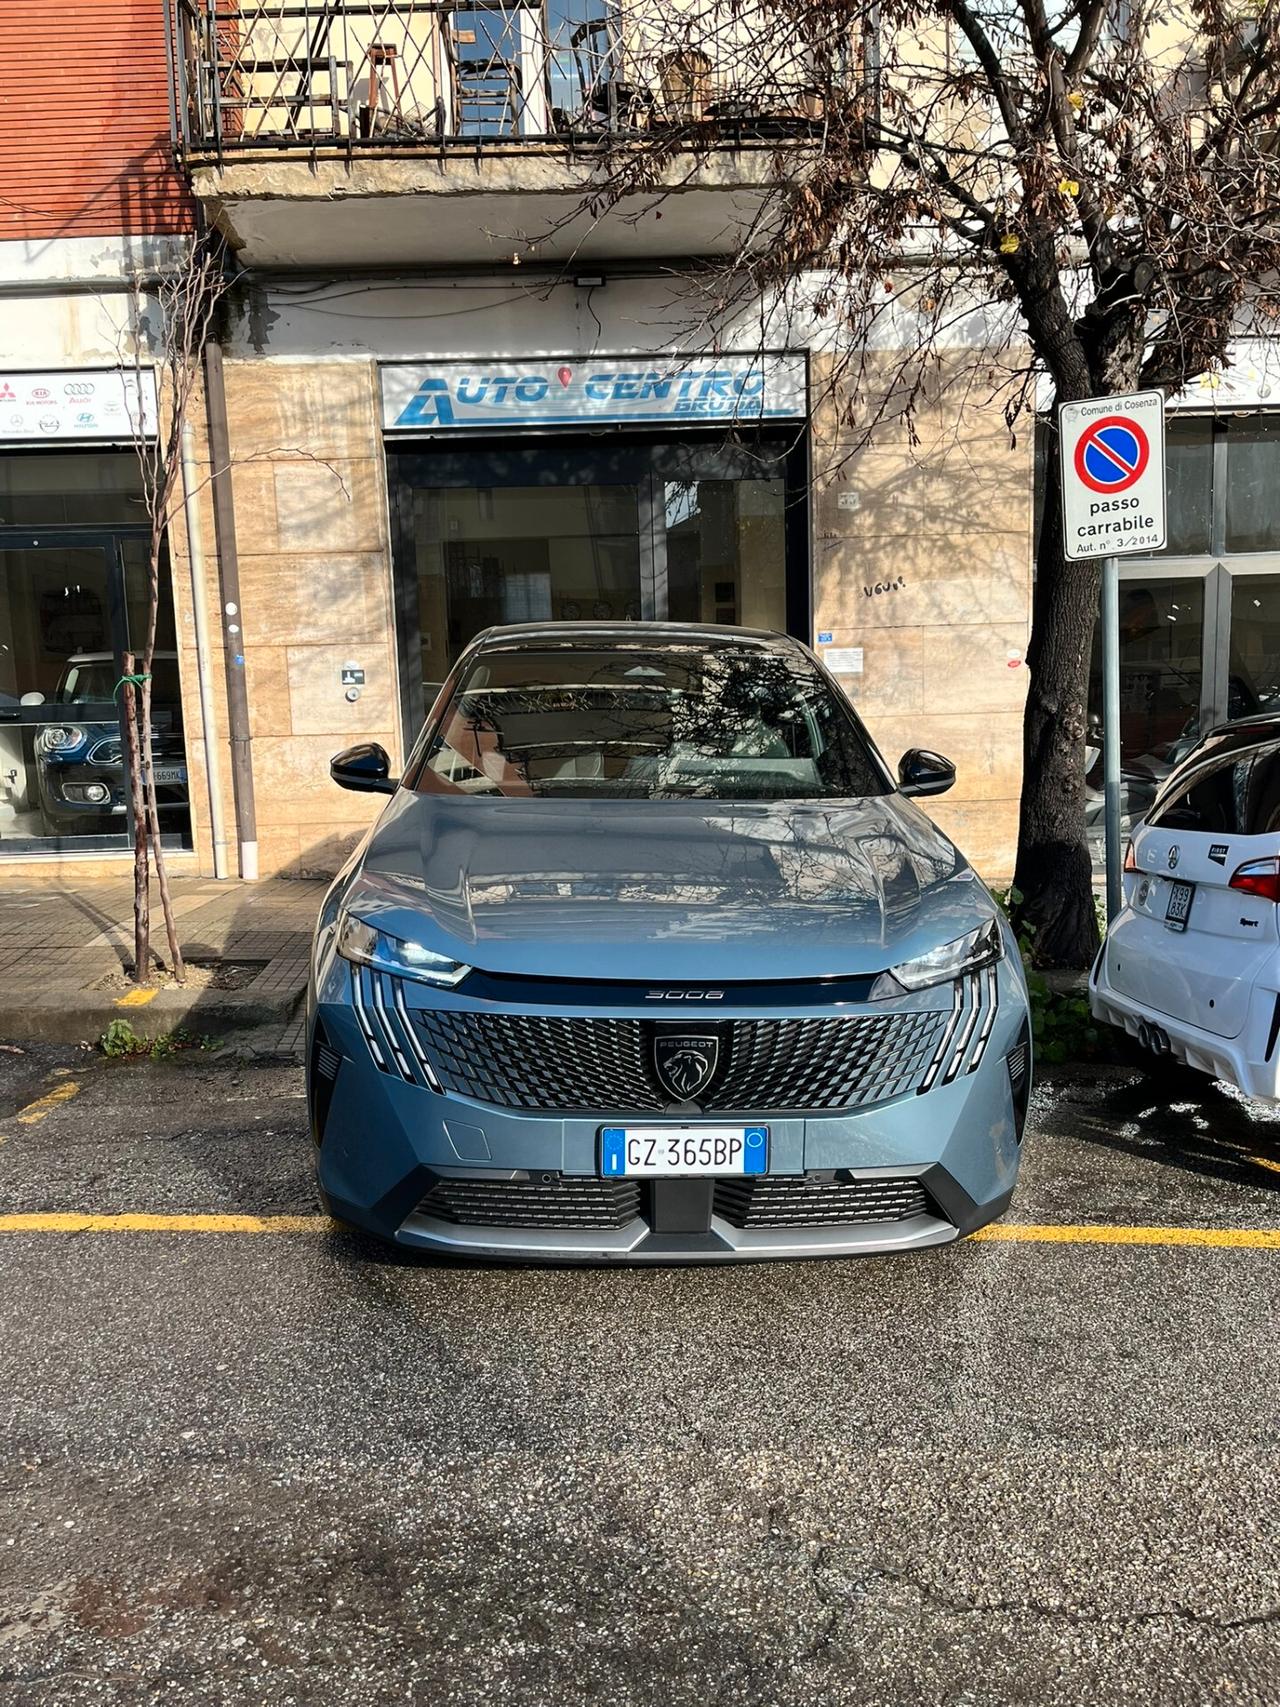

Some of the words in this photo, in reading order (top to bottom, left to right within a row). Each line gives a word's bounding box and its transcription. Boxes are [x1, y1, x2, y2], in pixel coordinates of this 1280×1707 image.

[393, 375, 549, 425] AUTO
[584, 370, 764, 400] CENTRO
[1080, 405, 1113, 417] Comune
[1115, 402, 1123, 412] di
[1124, 398, 1158, 410] Cosenza
[1090, 497, 1140, 516] passo
[1077, 515, 1154, 537] carrabile
[1076, 541, 1096, 553] Aut.
[1116, 533, 1159, 547] 3/2014
[645, 990, 725, 999] 3008
[627, 1138, 658, 1167] GZ
[666, 1138, 743, 1167] 365BP
